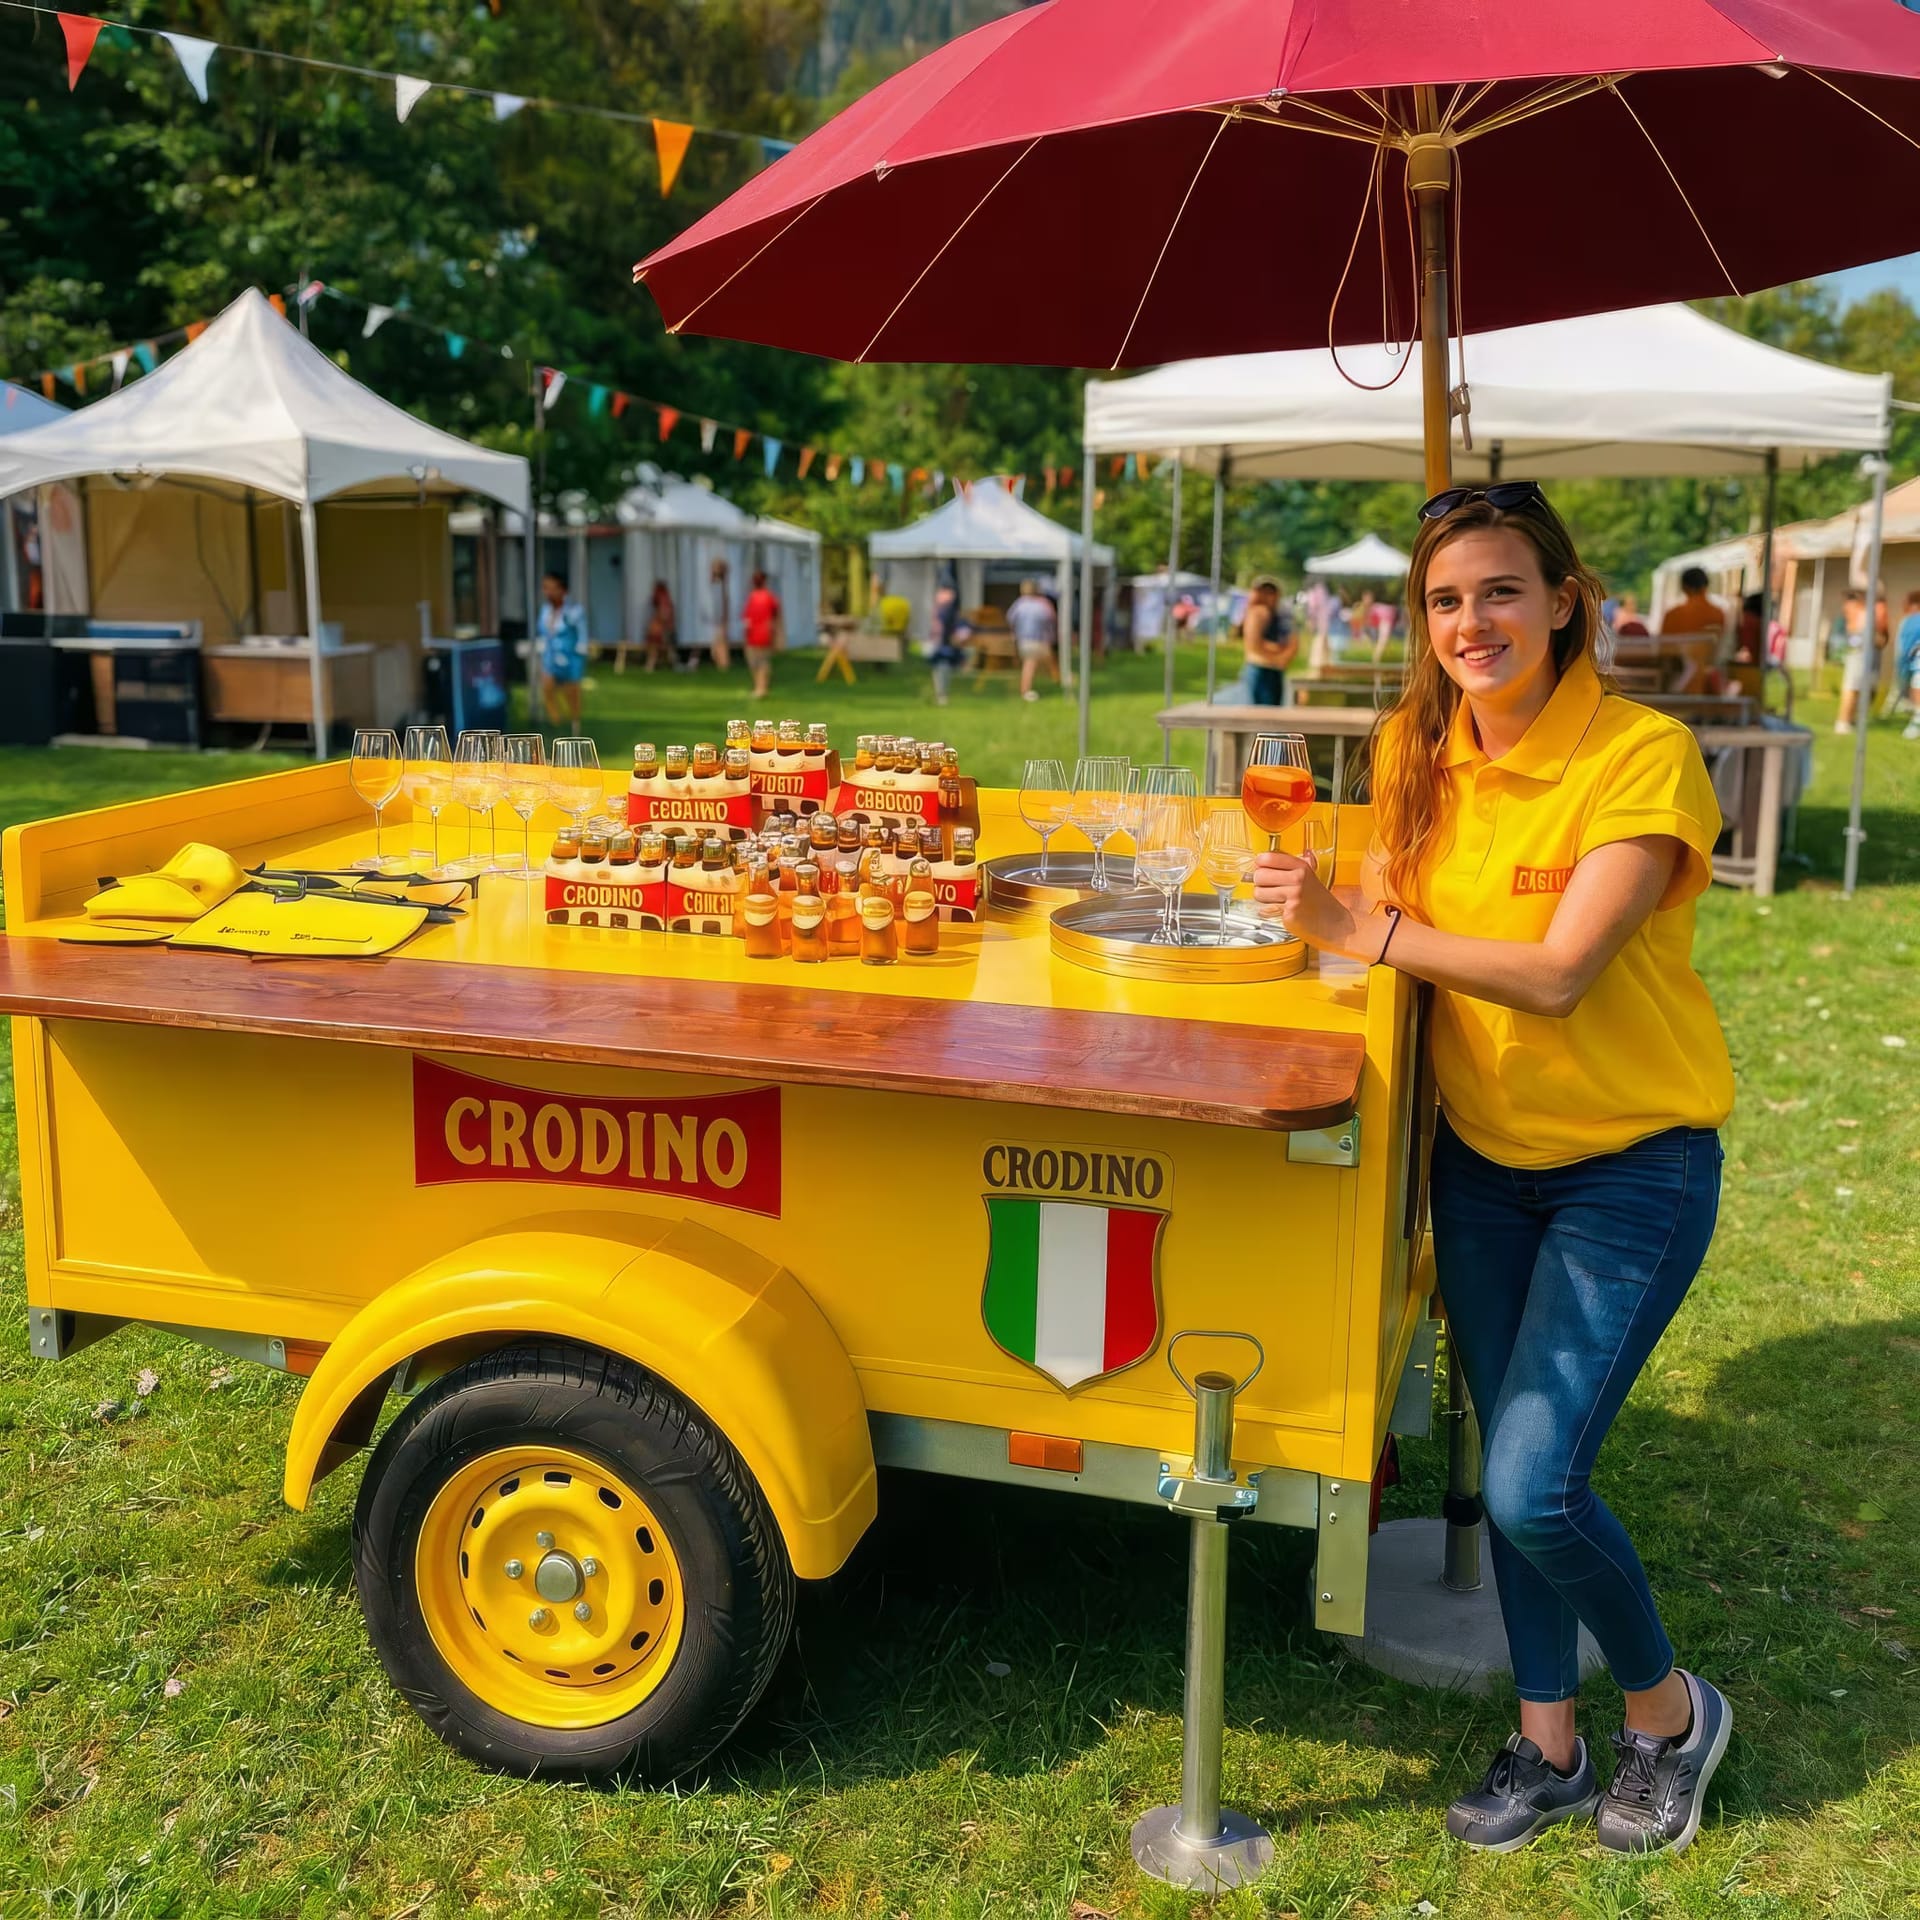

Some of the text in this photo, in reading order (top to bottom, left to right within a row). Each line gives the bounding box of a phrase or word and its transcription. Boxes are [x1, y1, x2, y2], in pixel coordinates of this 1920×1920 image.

[563, 885, 643, 908] CRODINO
[445, 1097, 748, 1189] CRODINO
[982, 1145, 1163, 1199] CRODINO
